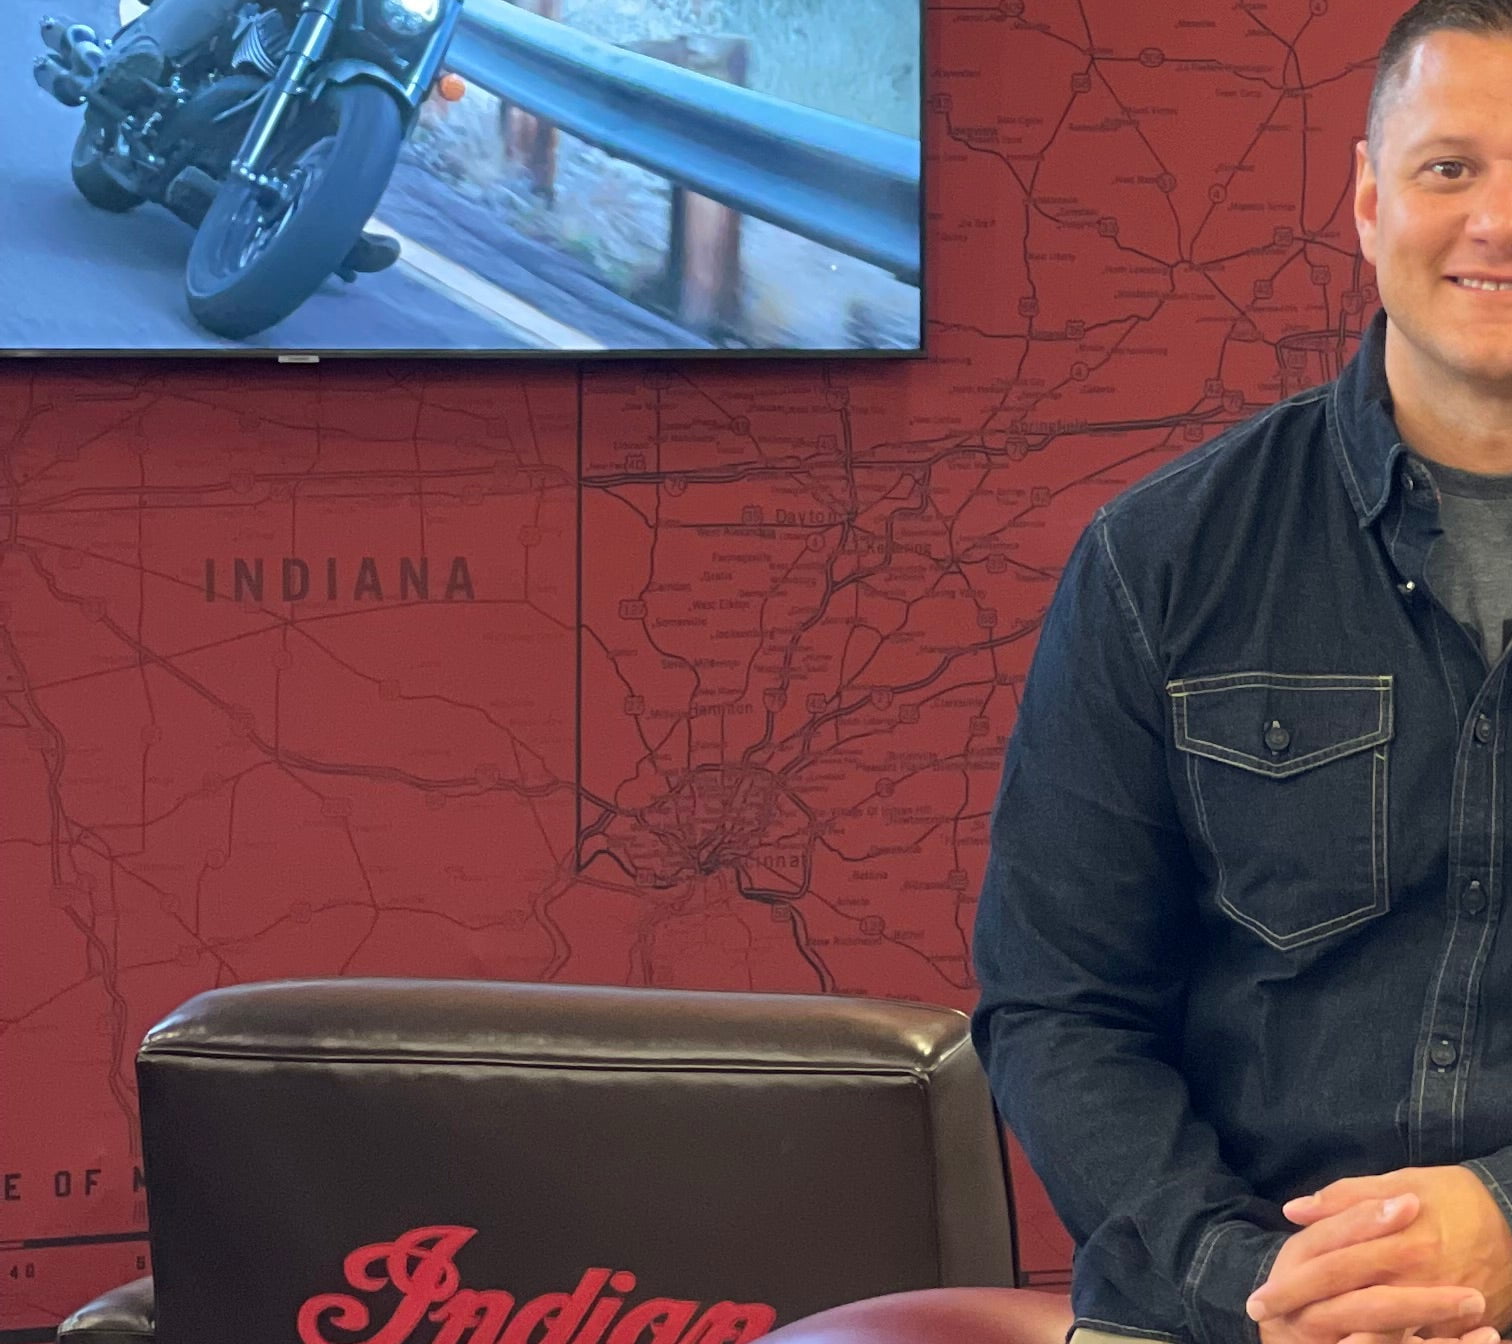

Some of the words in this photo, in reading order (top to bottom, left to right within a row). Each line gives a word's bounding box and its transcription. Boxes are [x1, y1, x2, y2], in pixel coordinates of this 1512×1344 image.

[1011, 418, 1088, 436] Springfield
[776, 507, 839, 529] Dayton
[205, 556, 477, 603] INDIANA
[54, 1169, 102, 1198] OF
[9, 1262, 36, 1281] 40
